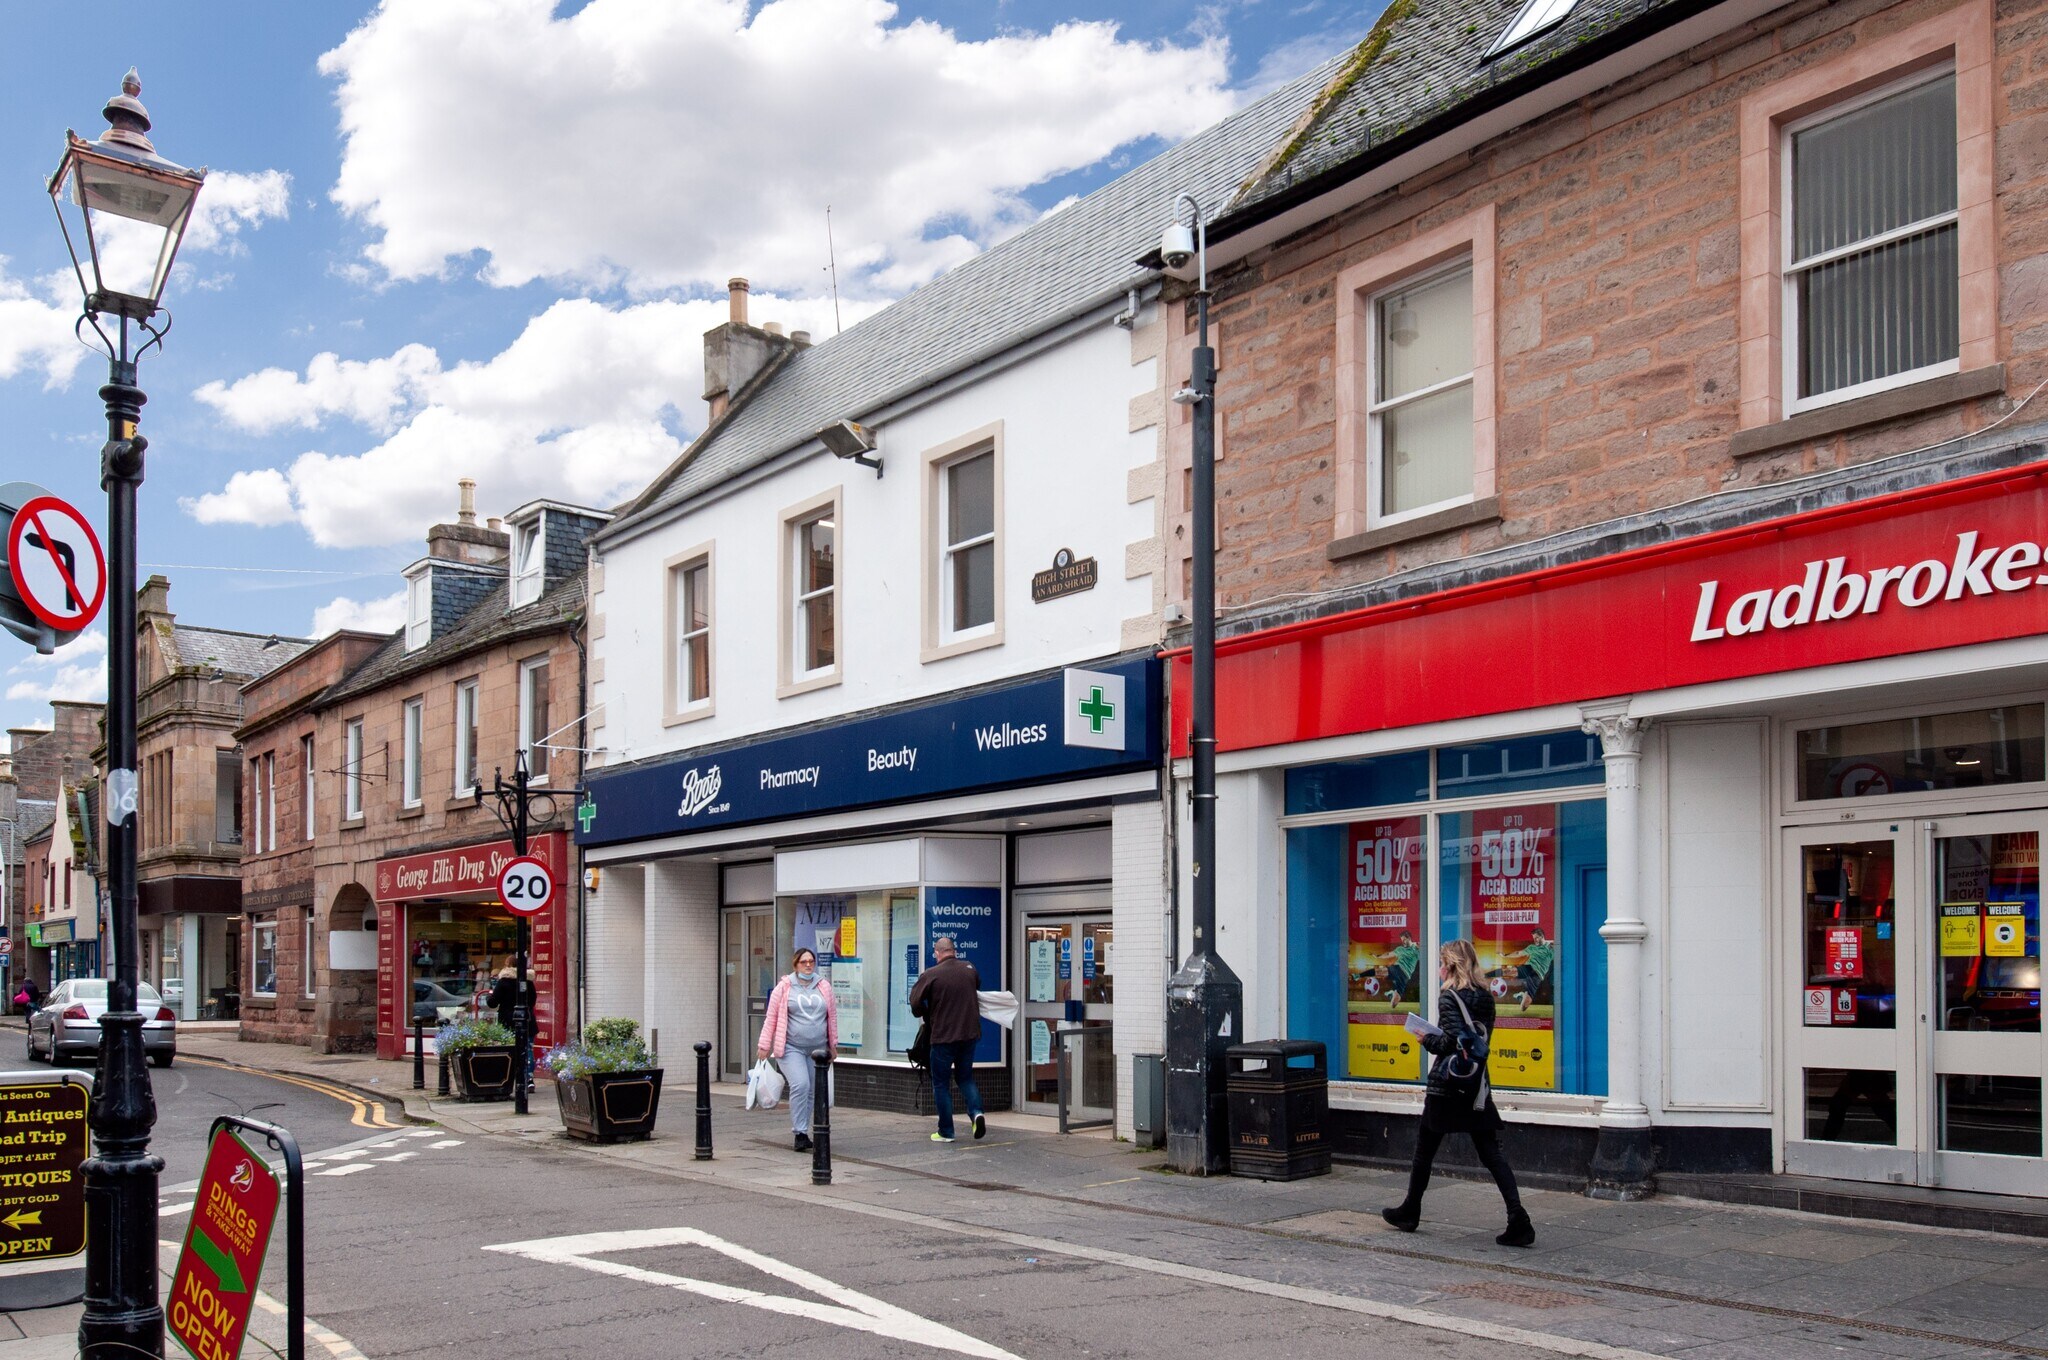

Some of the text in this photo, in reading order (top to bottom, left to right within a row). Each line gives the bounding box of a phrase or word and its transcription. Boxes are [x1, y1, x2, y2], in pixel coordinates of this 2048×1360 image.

[1035, 562, 1092, 587] HIGH STREET
[1035, 575, 1093, 598] AN ARD SHRAID
[975, 722, 1047, 752] Wellness
[868, 745, 917, 771] Beauty
[760, 765, 820, 790] Pharmacy
[678, 764, 722, 817] Boots
[1503, 814, 1523, 827] UP TO
[1375, 825, 1392, 837] UP TO
[1356, 836, 1411, 884] 50%
[1481, 827, 1544, 878] 50%
[396, 850, 515, 891] George Ellis Drug Sto
[507, 874, 547, 900] 20
[1354, 884, 1412, 901] ACCA BOOST
[1479, 878, 1545, 895] ACCA BOOST
[932, 903, 992, 916] welcome
[1488, 911, 1513, 923] INCLUDES
[1944, 906, 1976, 915] WELCOME
[1988, 905, 2021, 915] WELCOME
[932, 921, 970, 930] pharmacy
[932, 931, 958, 939] beauty
[960, 941, 978, 949] child
[1840, 1001, 1850, 1010] 18
[1372, 1043, 1388, 1052] FUN
[1498, 1048, 1518, 1059] FUN
[9, 1091, 34, 1100] Seen
[35, 1090, 51, 1099] On
[4, 1109, 84, 1125] Antiques
[0, 1130, 67, 1145] ad Trip
[1296, 1132, 1320, 1142] LITTER
[25, 1152, 57, 1162] d'ART
[4, 1196, 26, 1206] BUY
[28, 1193, 60, 1204] GOLD
[210, 1181, 258, 1239] DINGS
[205, 1204, 252, 1257] & TAKEAWAY
[183, 1269, 237, 1339] NOW
